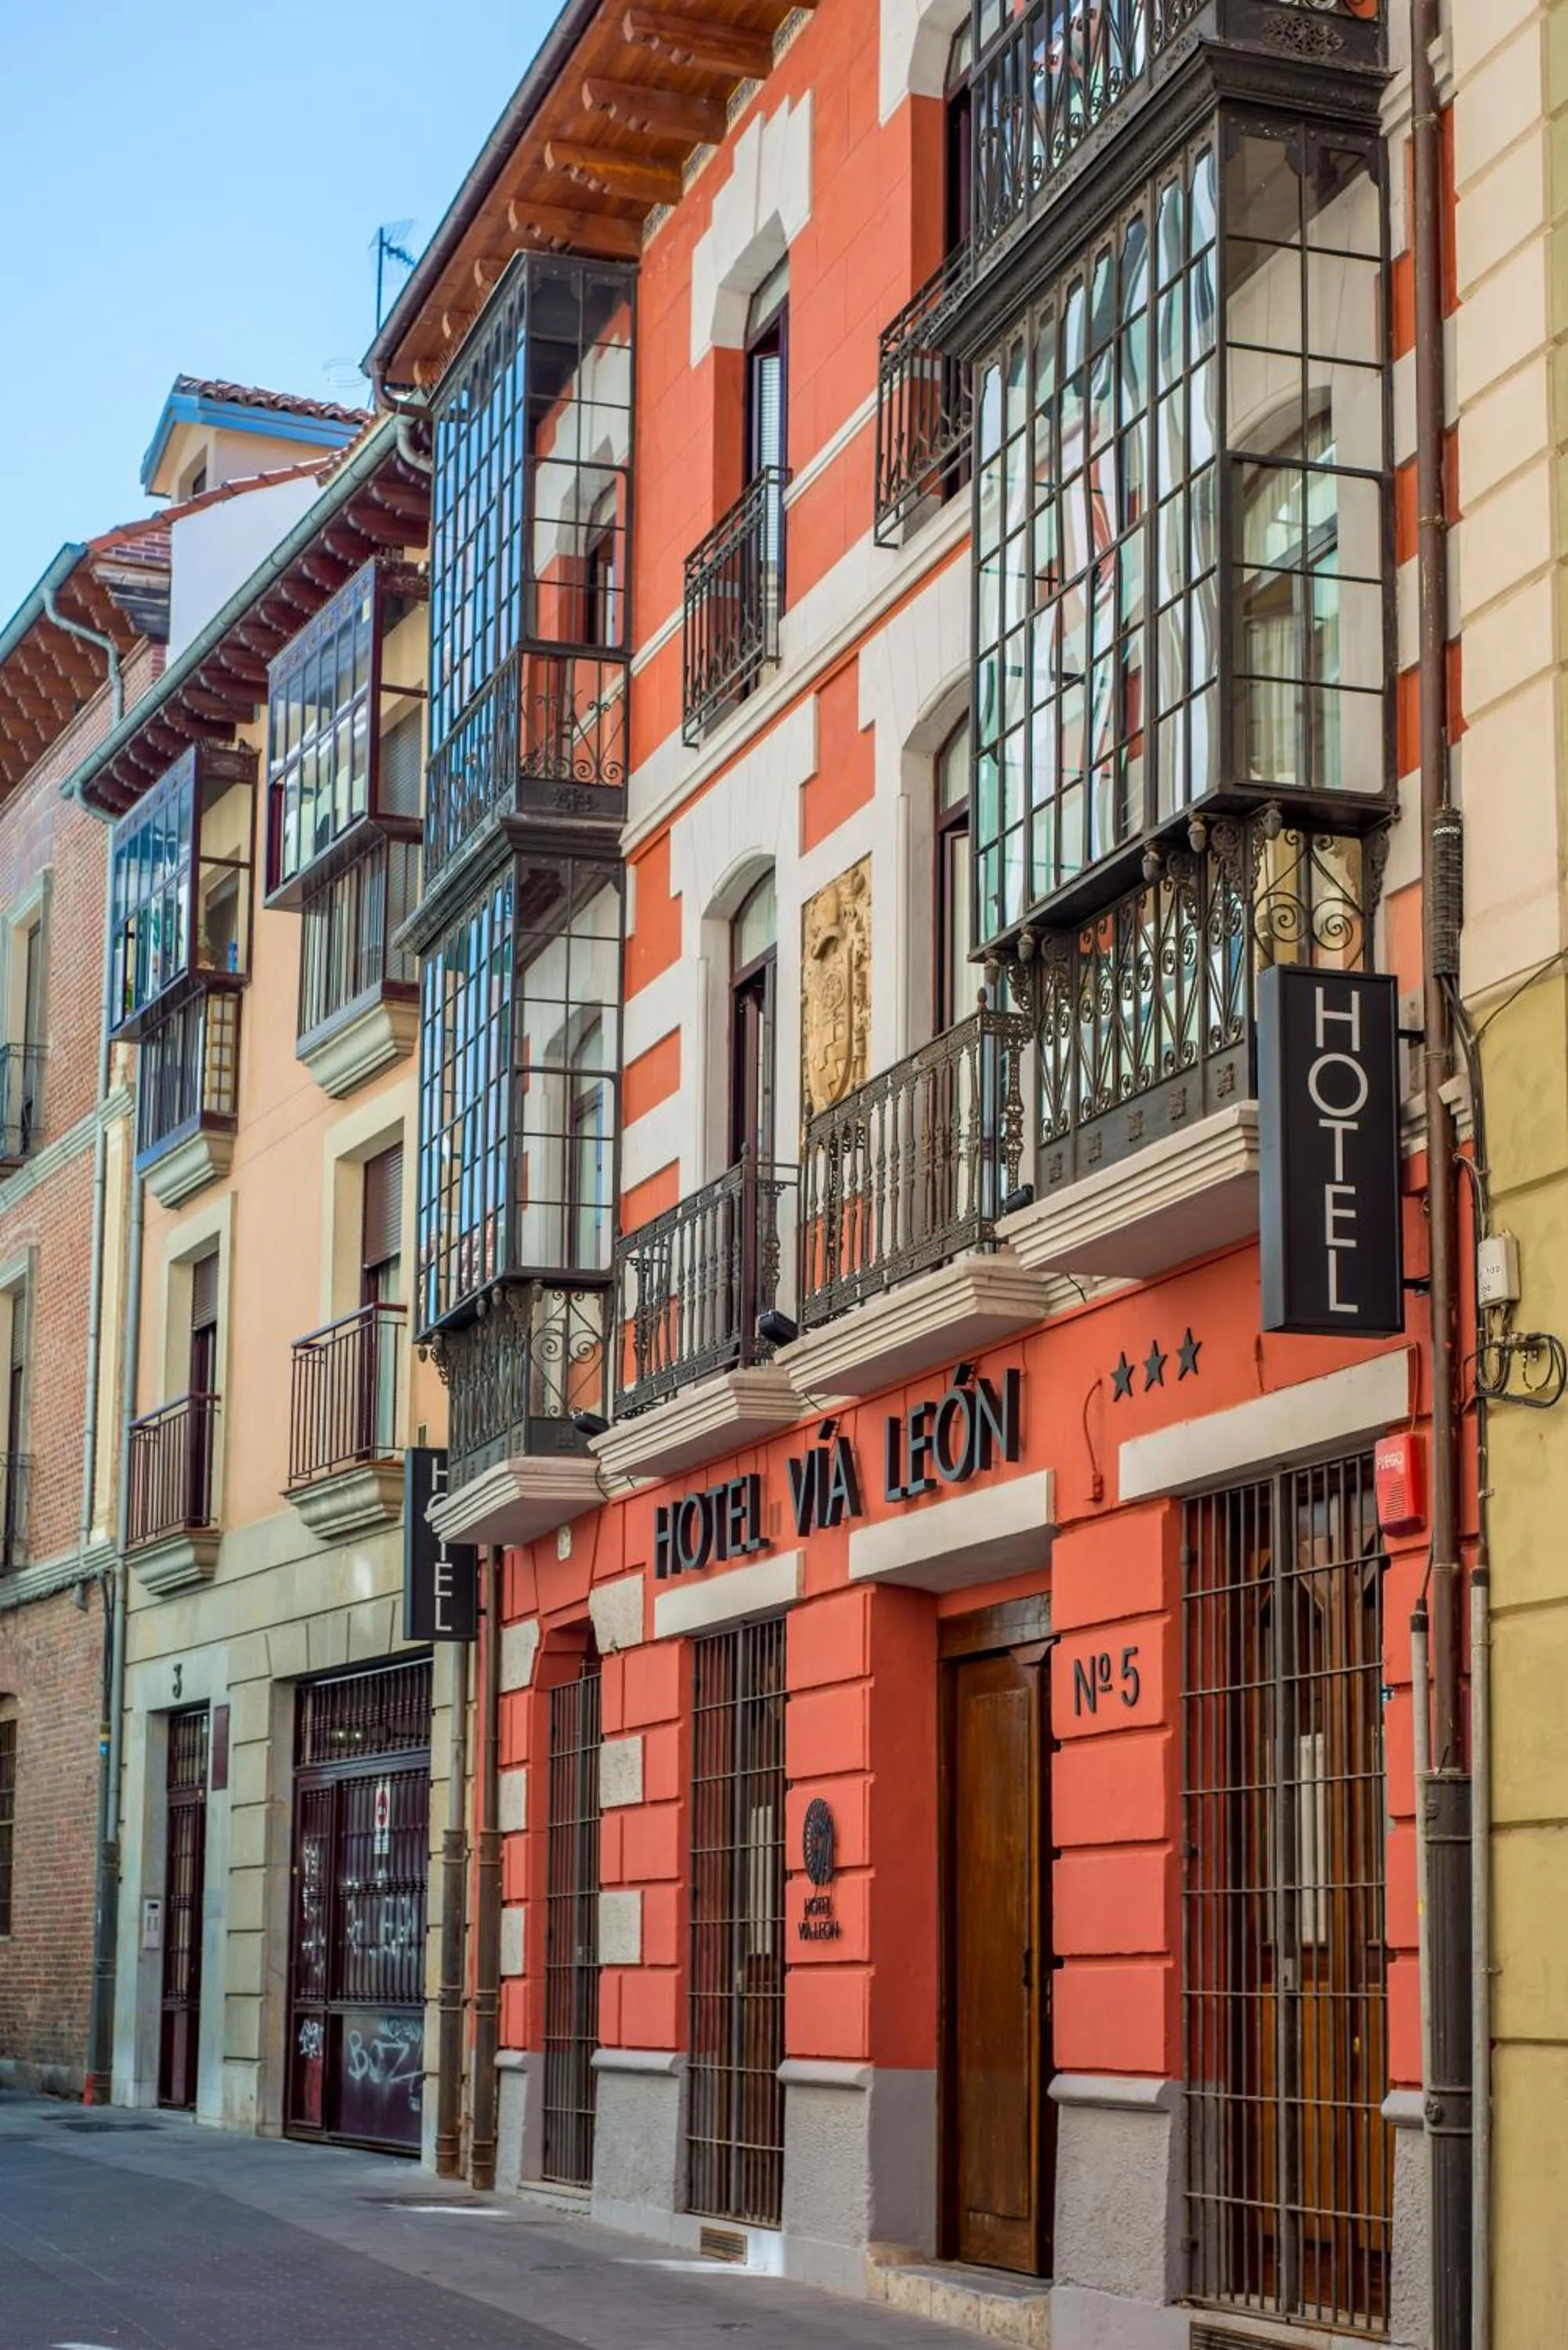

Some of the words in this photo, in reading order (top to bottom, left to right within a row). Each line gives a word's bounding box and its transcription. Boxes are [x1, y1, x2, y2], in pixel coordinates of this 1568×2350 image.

[1307, 985, 1368, 1313] HOTEL
[655, 1473, 770, 1579] HOTEL
[789, 1419, 862, 1537] VÍA
[884, 1363, 1021, 1502] LEÓN
[804, 1896, 830, 1917] HOTEL
